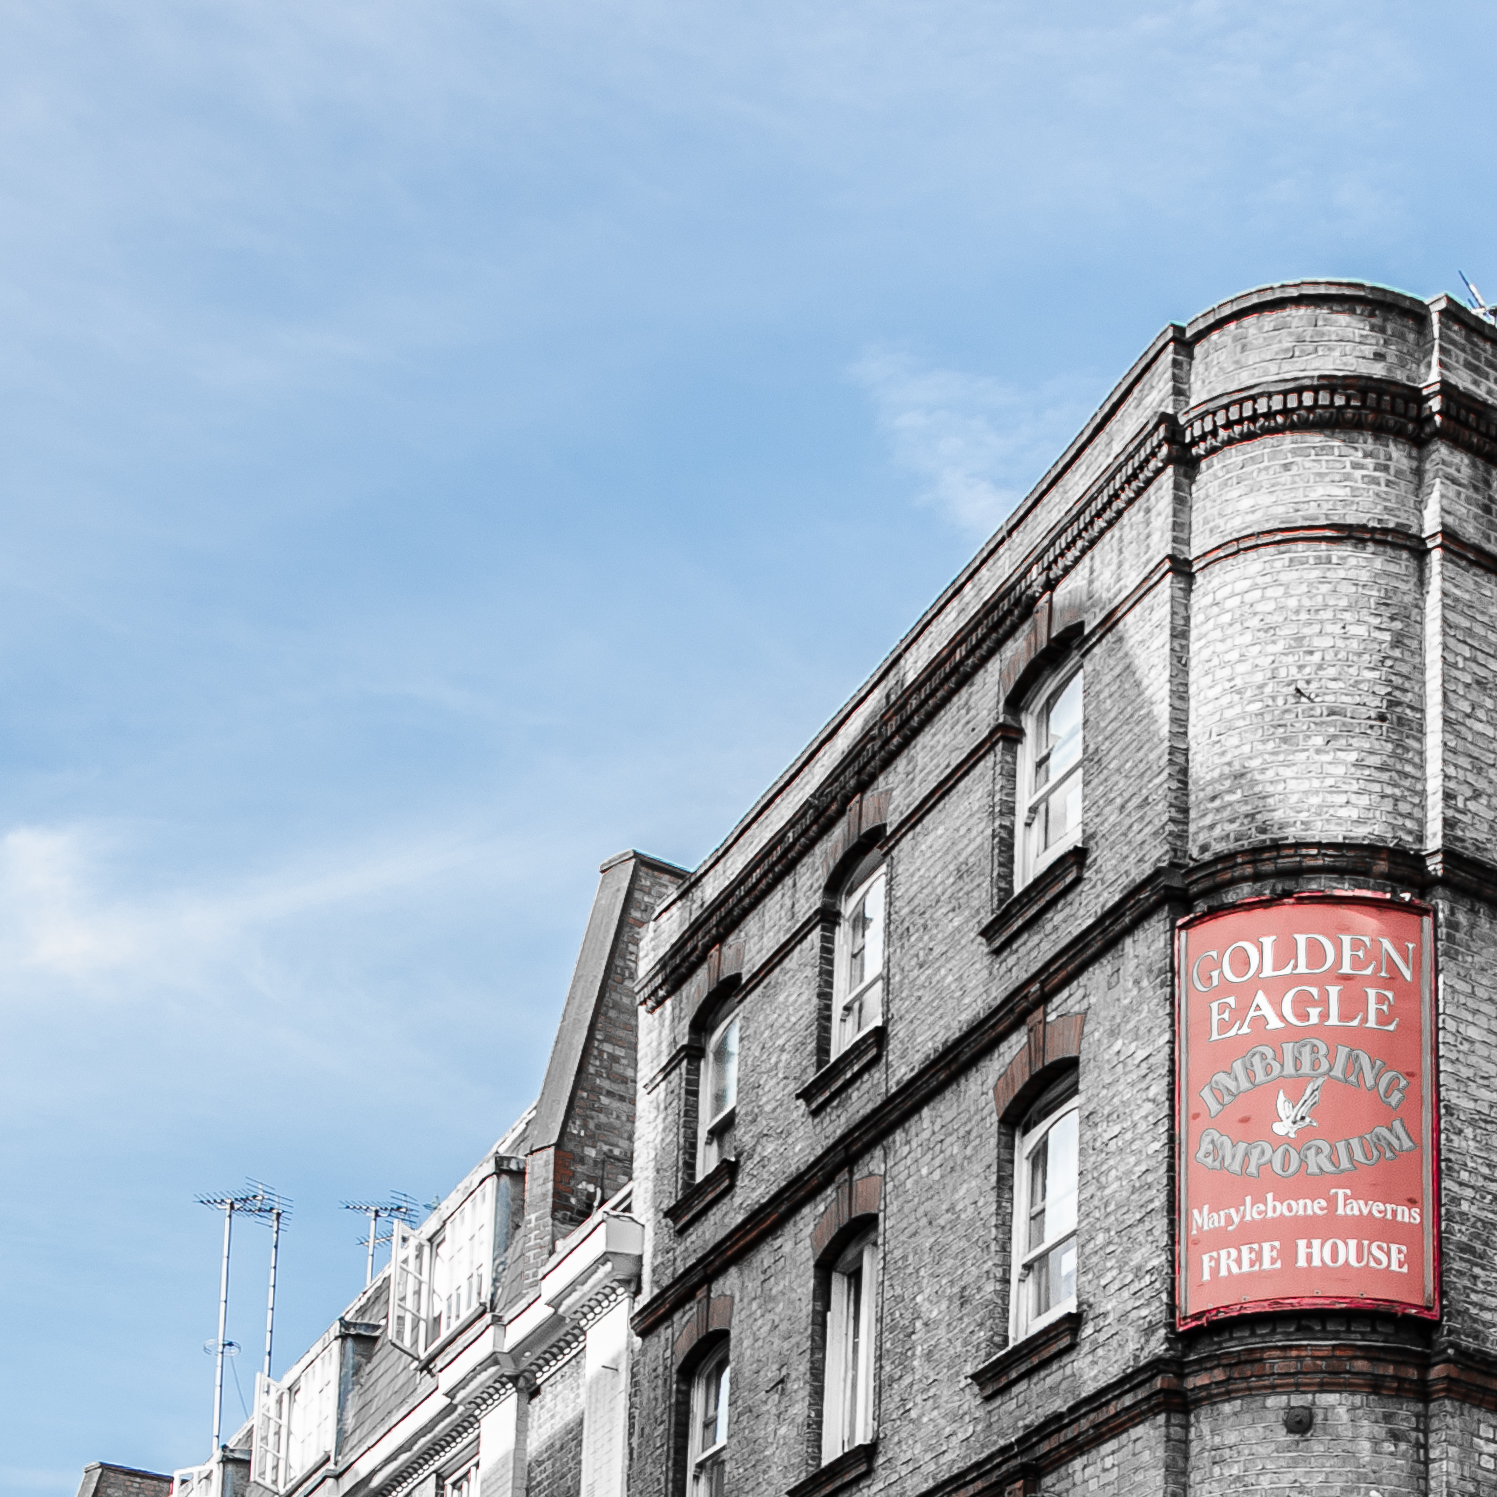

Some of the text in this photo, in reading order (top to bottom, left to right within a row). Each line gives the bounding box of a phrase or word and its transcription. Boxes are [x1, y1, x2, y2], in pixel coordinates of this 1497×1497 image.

[1192, 933, 1417, 993] GOLDEN
[1208, 985, 1399, 1042] EAGLE
[1199, 1038, 1410, 1118] IMBIBING
[1195, 1118, 1419, 1178] EMPORIUM
[1191, 1188, 1421, 1236] Marylebone Taverns
[1201, 1238, 1408, 1283] FREE HOUSE
